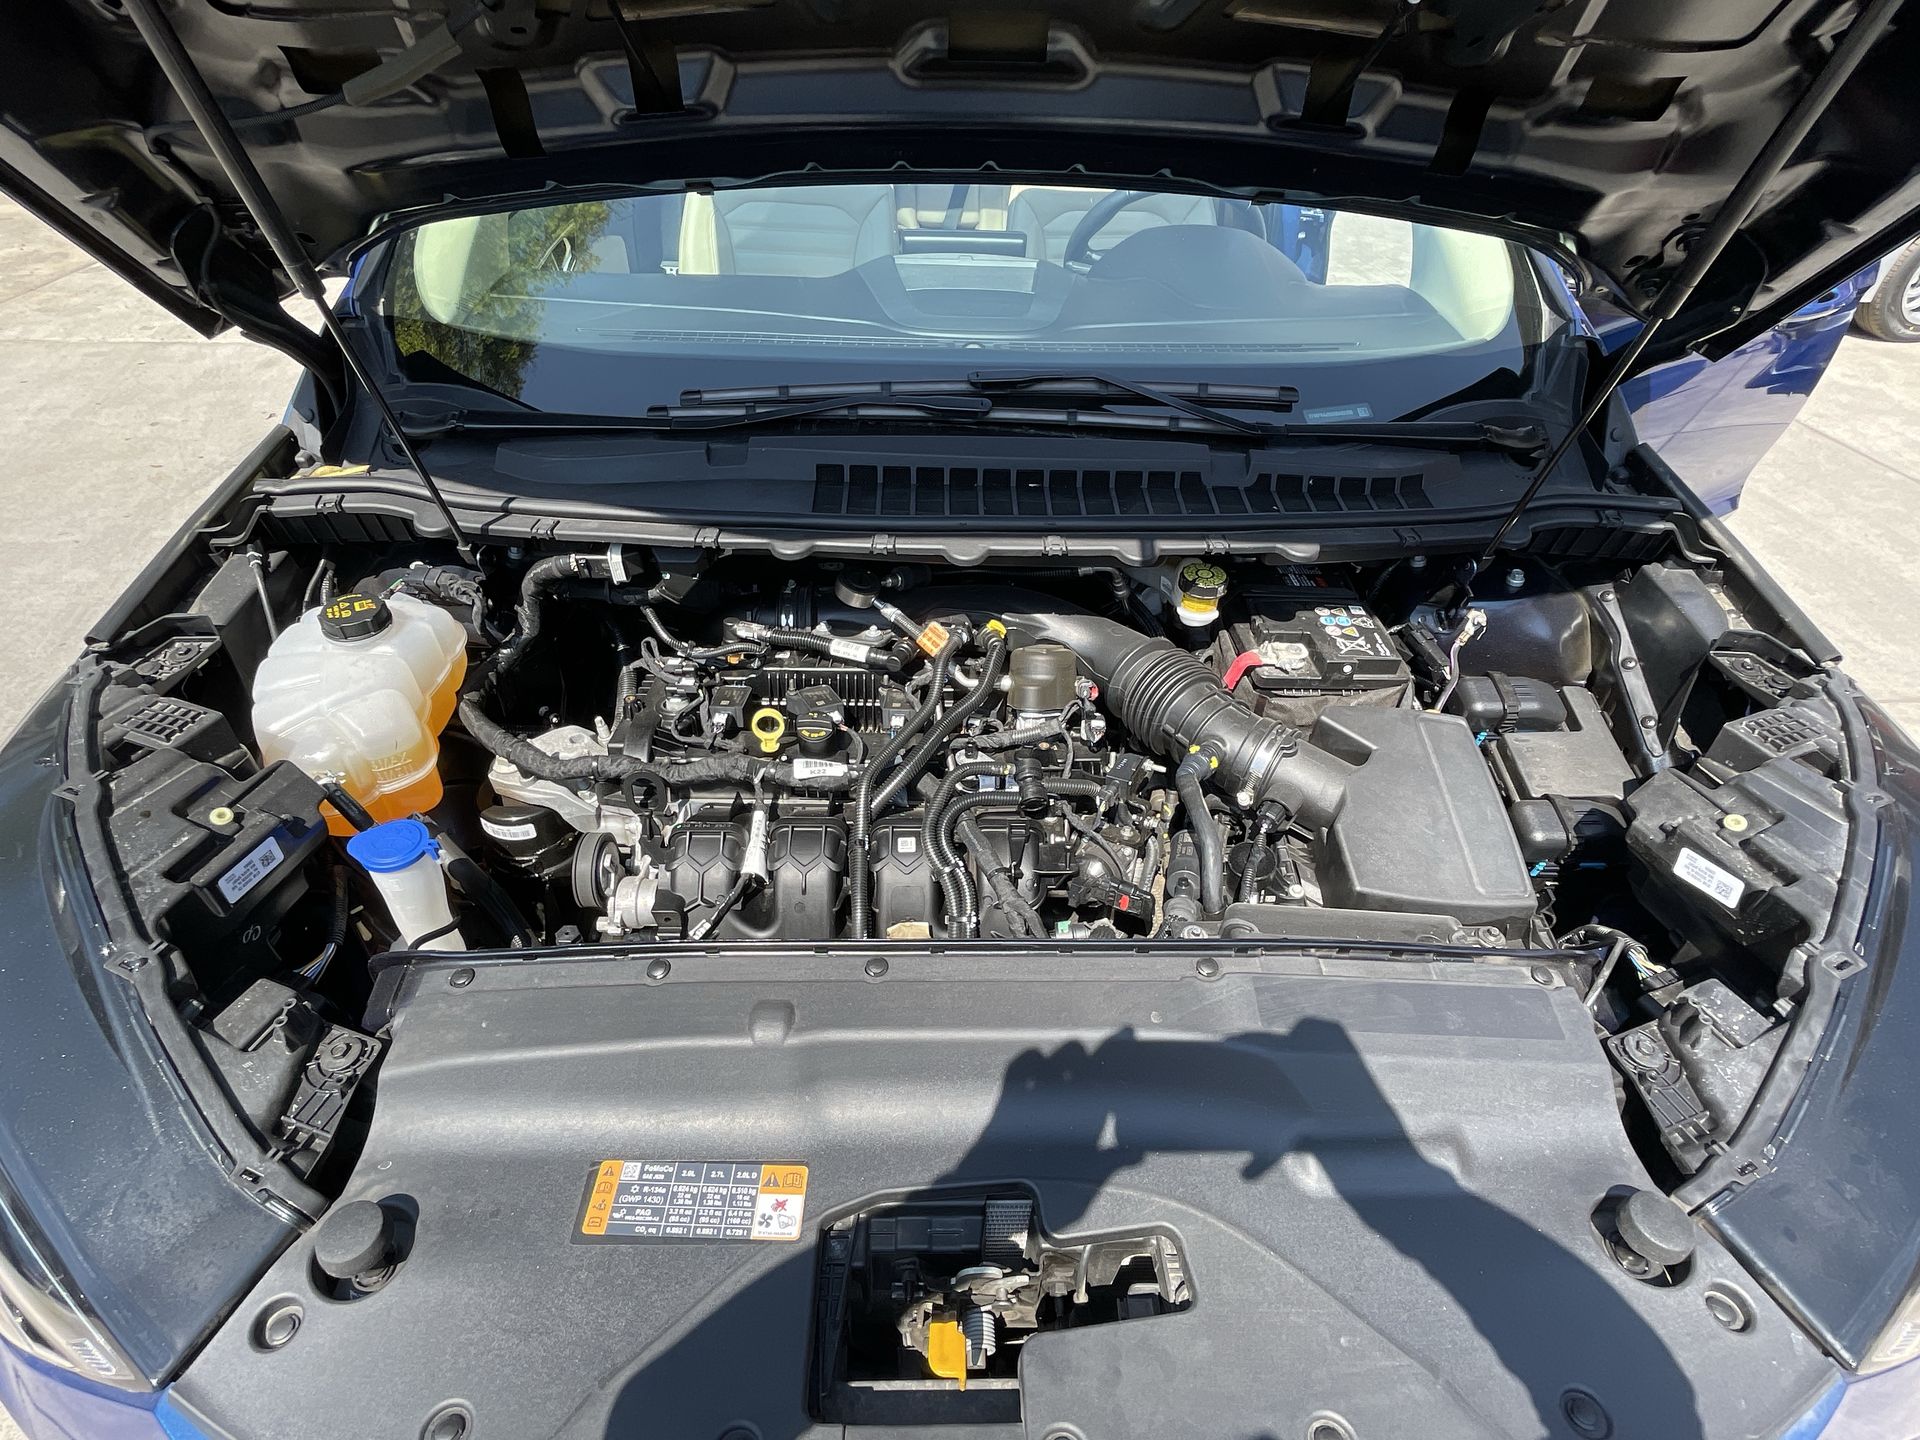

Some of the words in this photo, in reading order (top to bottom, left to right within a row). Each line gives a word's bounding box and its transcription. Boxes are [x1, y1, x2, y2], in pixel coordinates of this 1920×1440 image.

[644, 1165, 674, 1173] FoMoCo
[643, 1186, 666, 1194] R-134a
[619, 1195, 641, 1203] (GWP
[644, 1195, 664, 1205] 1430)
